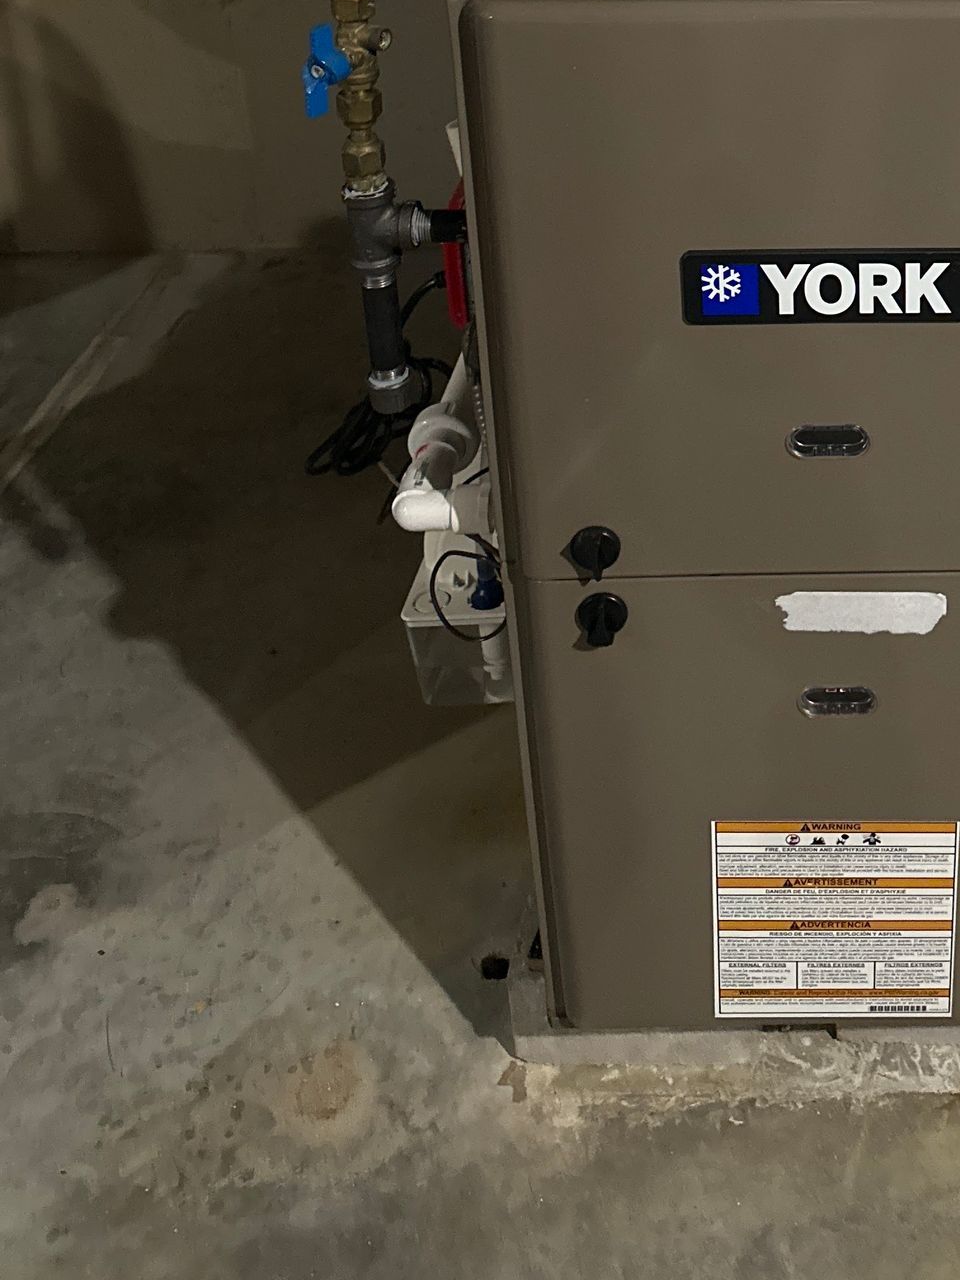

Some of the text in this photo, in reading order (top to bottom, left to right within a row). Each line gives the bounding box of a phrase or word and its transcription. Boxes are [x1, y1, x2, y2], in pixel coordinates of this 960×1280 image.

[760, 262, 952, 315] YORK
[811, 823, 862, 831] WARNING
[793, 878, 879, 886] AVERTISSEMENT
[800, 920, 871, 929] ADVERTENCIA
